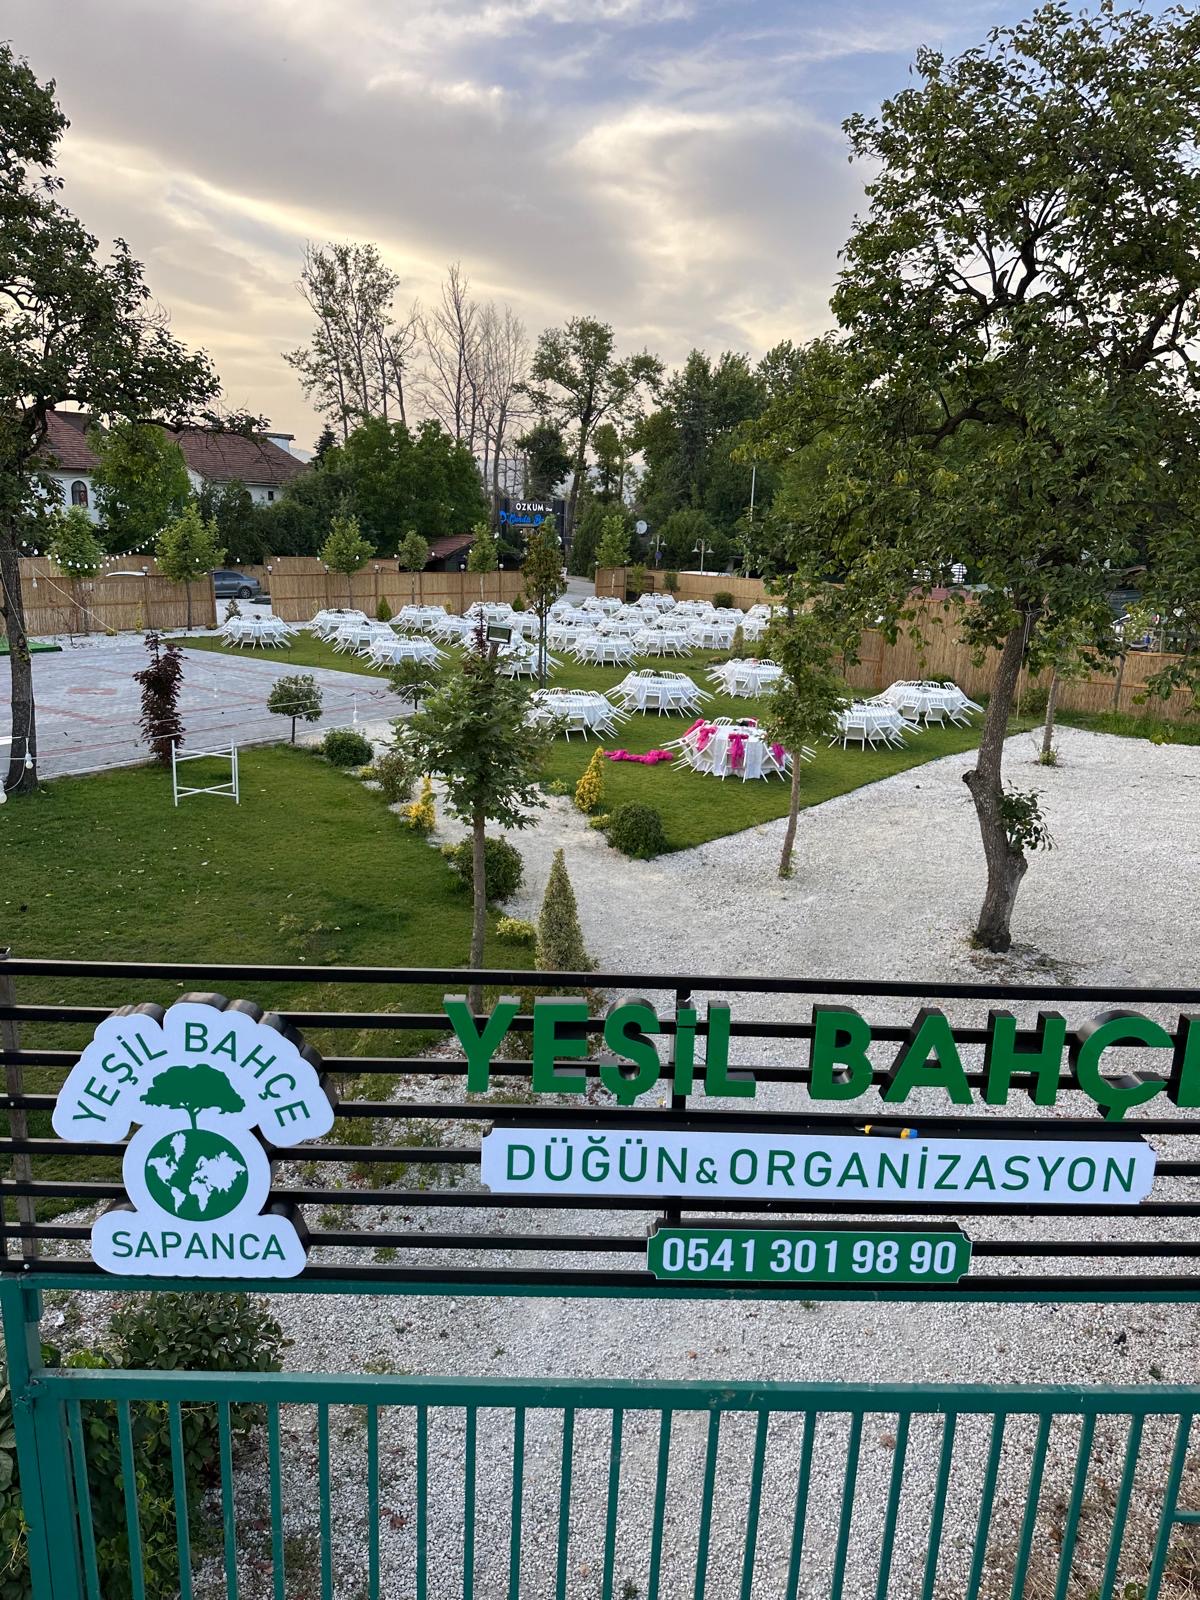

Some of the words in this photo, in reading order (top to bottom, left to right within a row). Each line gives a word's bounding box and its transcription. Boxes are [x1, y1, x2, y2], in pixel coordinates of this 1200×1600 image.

[72, 1033, 168, 1124] YEŞİL
[184, 1021, 311, 1128] BAHÇE
[111, 1230, 286, 1261] SAPANCA
[661, 1237, 756, 1273] 0541
[770, 1238, 839, 1273] 301
[851, 1240, 900, 1275] 98
[909, 1240, 958, 1275] 90
